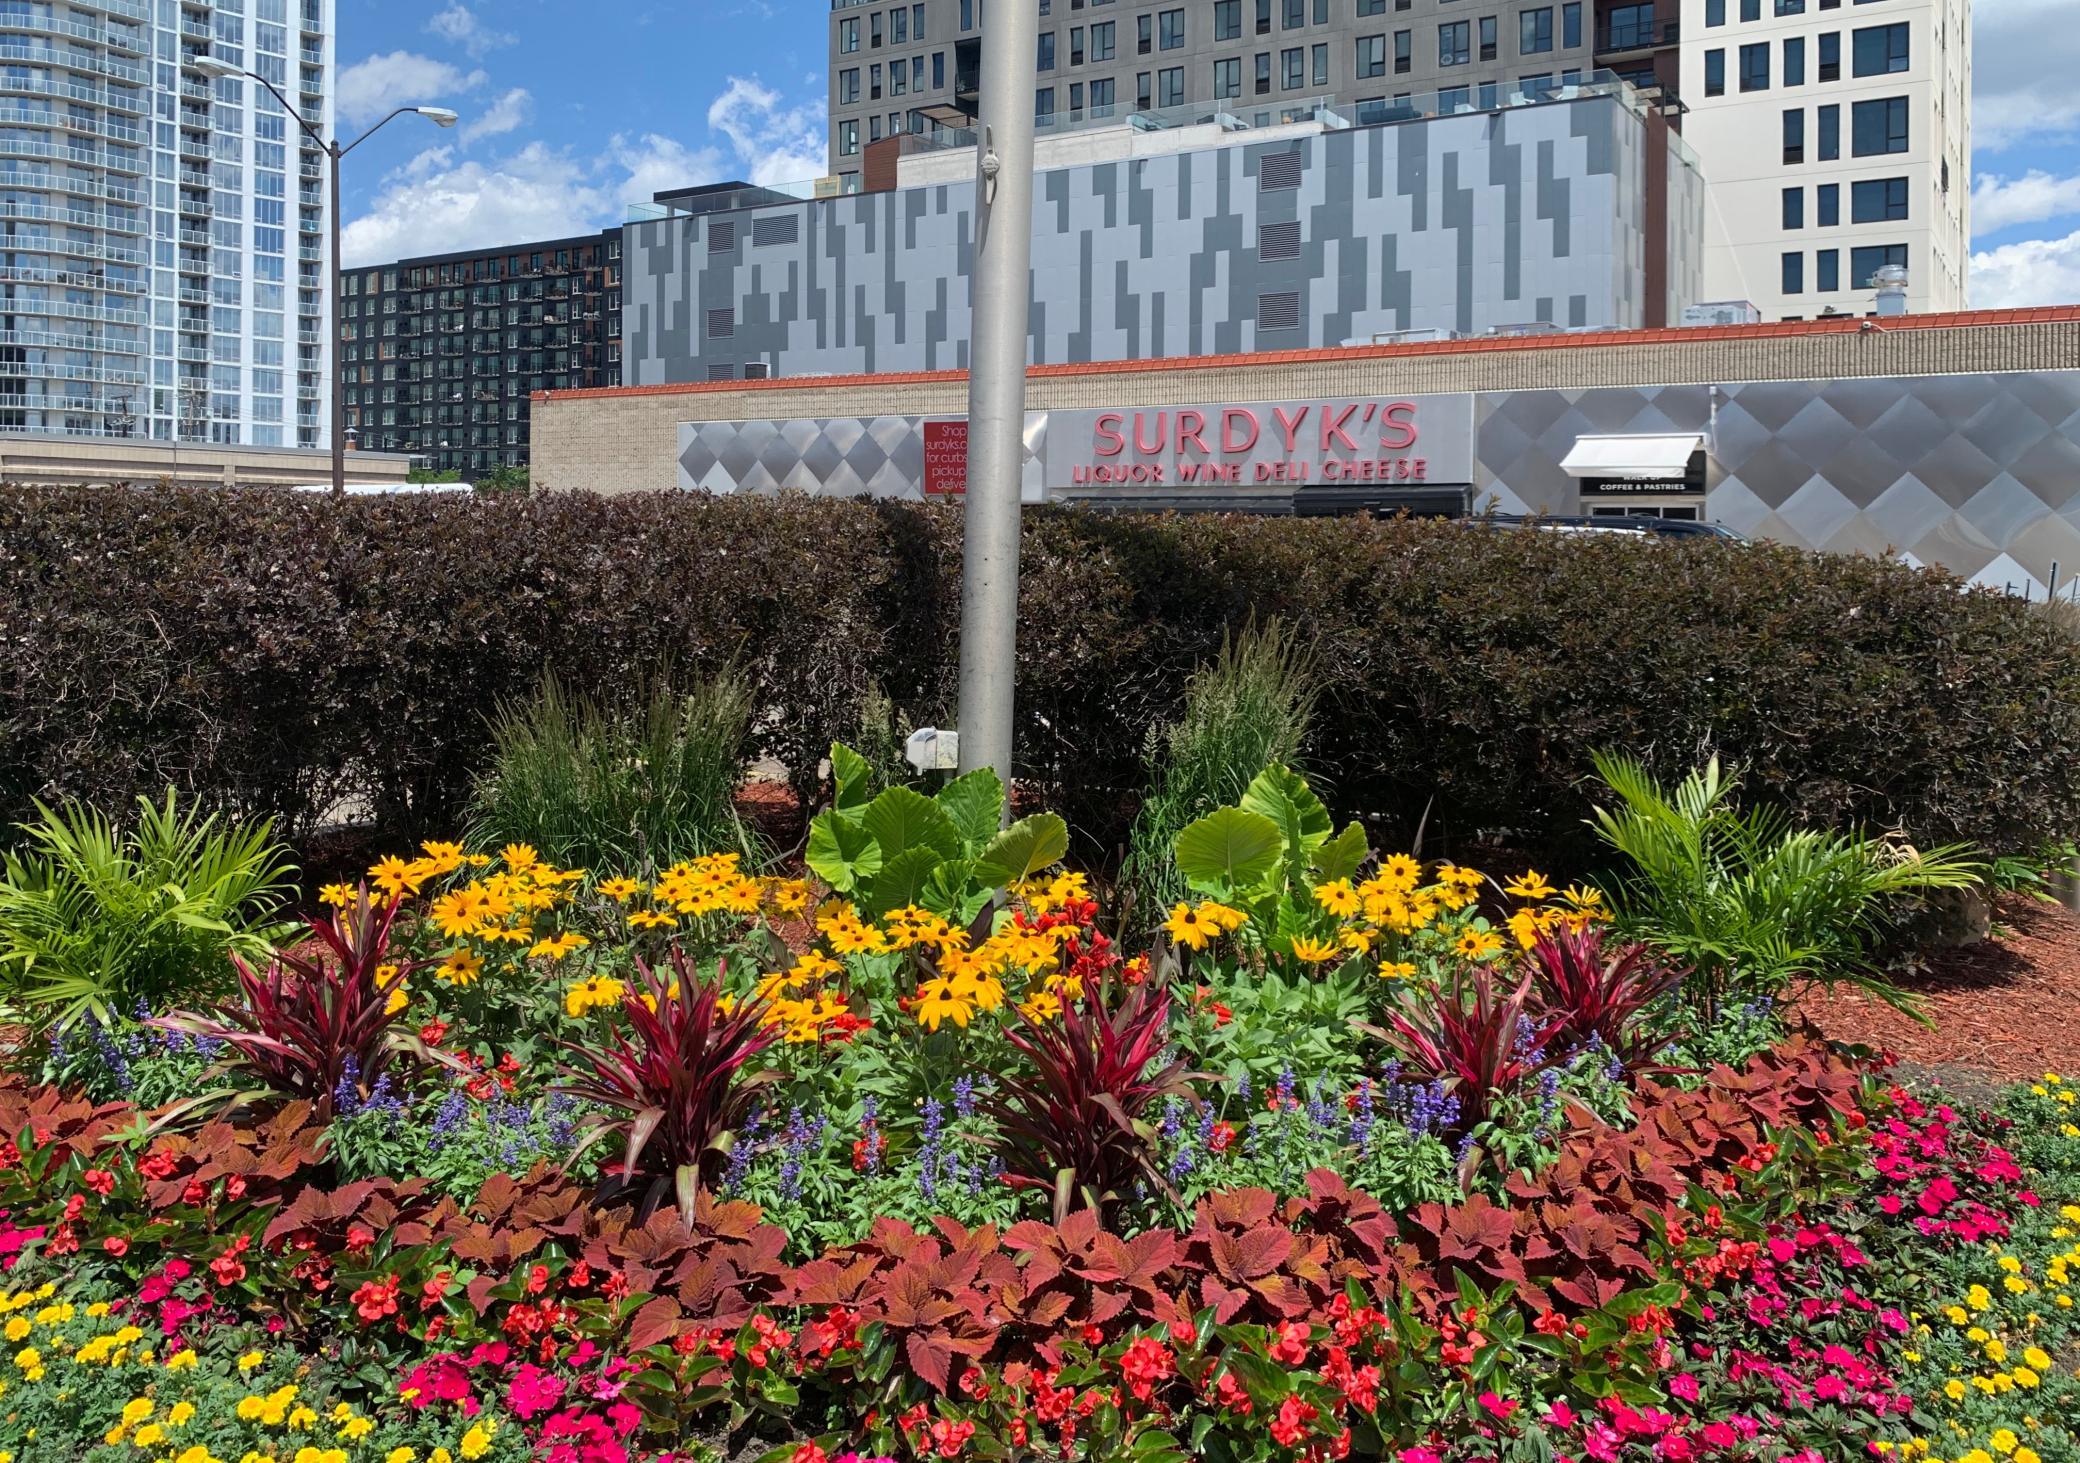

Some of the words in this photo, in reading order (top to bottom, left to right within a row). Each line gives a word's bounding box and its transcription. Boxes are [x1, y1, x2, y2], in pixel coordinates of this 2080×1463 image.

[942, 425, 967, 438] Shop
[1094, 402, 1418, 456] SURDYK'S
[926, 439, 967, 451] surdyks.c
[926, 452, 939, 463] for
[940, 452, 967, 463] curbs
[932, 465, 966, 478] pickup
[1073, 464, 1165, 483] LIQUOR
[1177, 463, 1242, 482] WINE
[1255, 461, 1310, 481] DELI
[1323, 458, 1427, 480] CHEESE
[936, 478, 967, 489] delive
[1600, 483, 1633, 491] COFFEE
